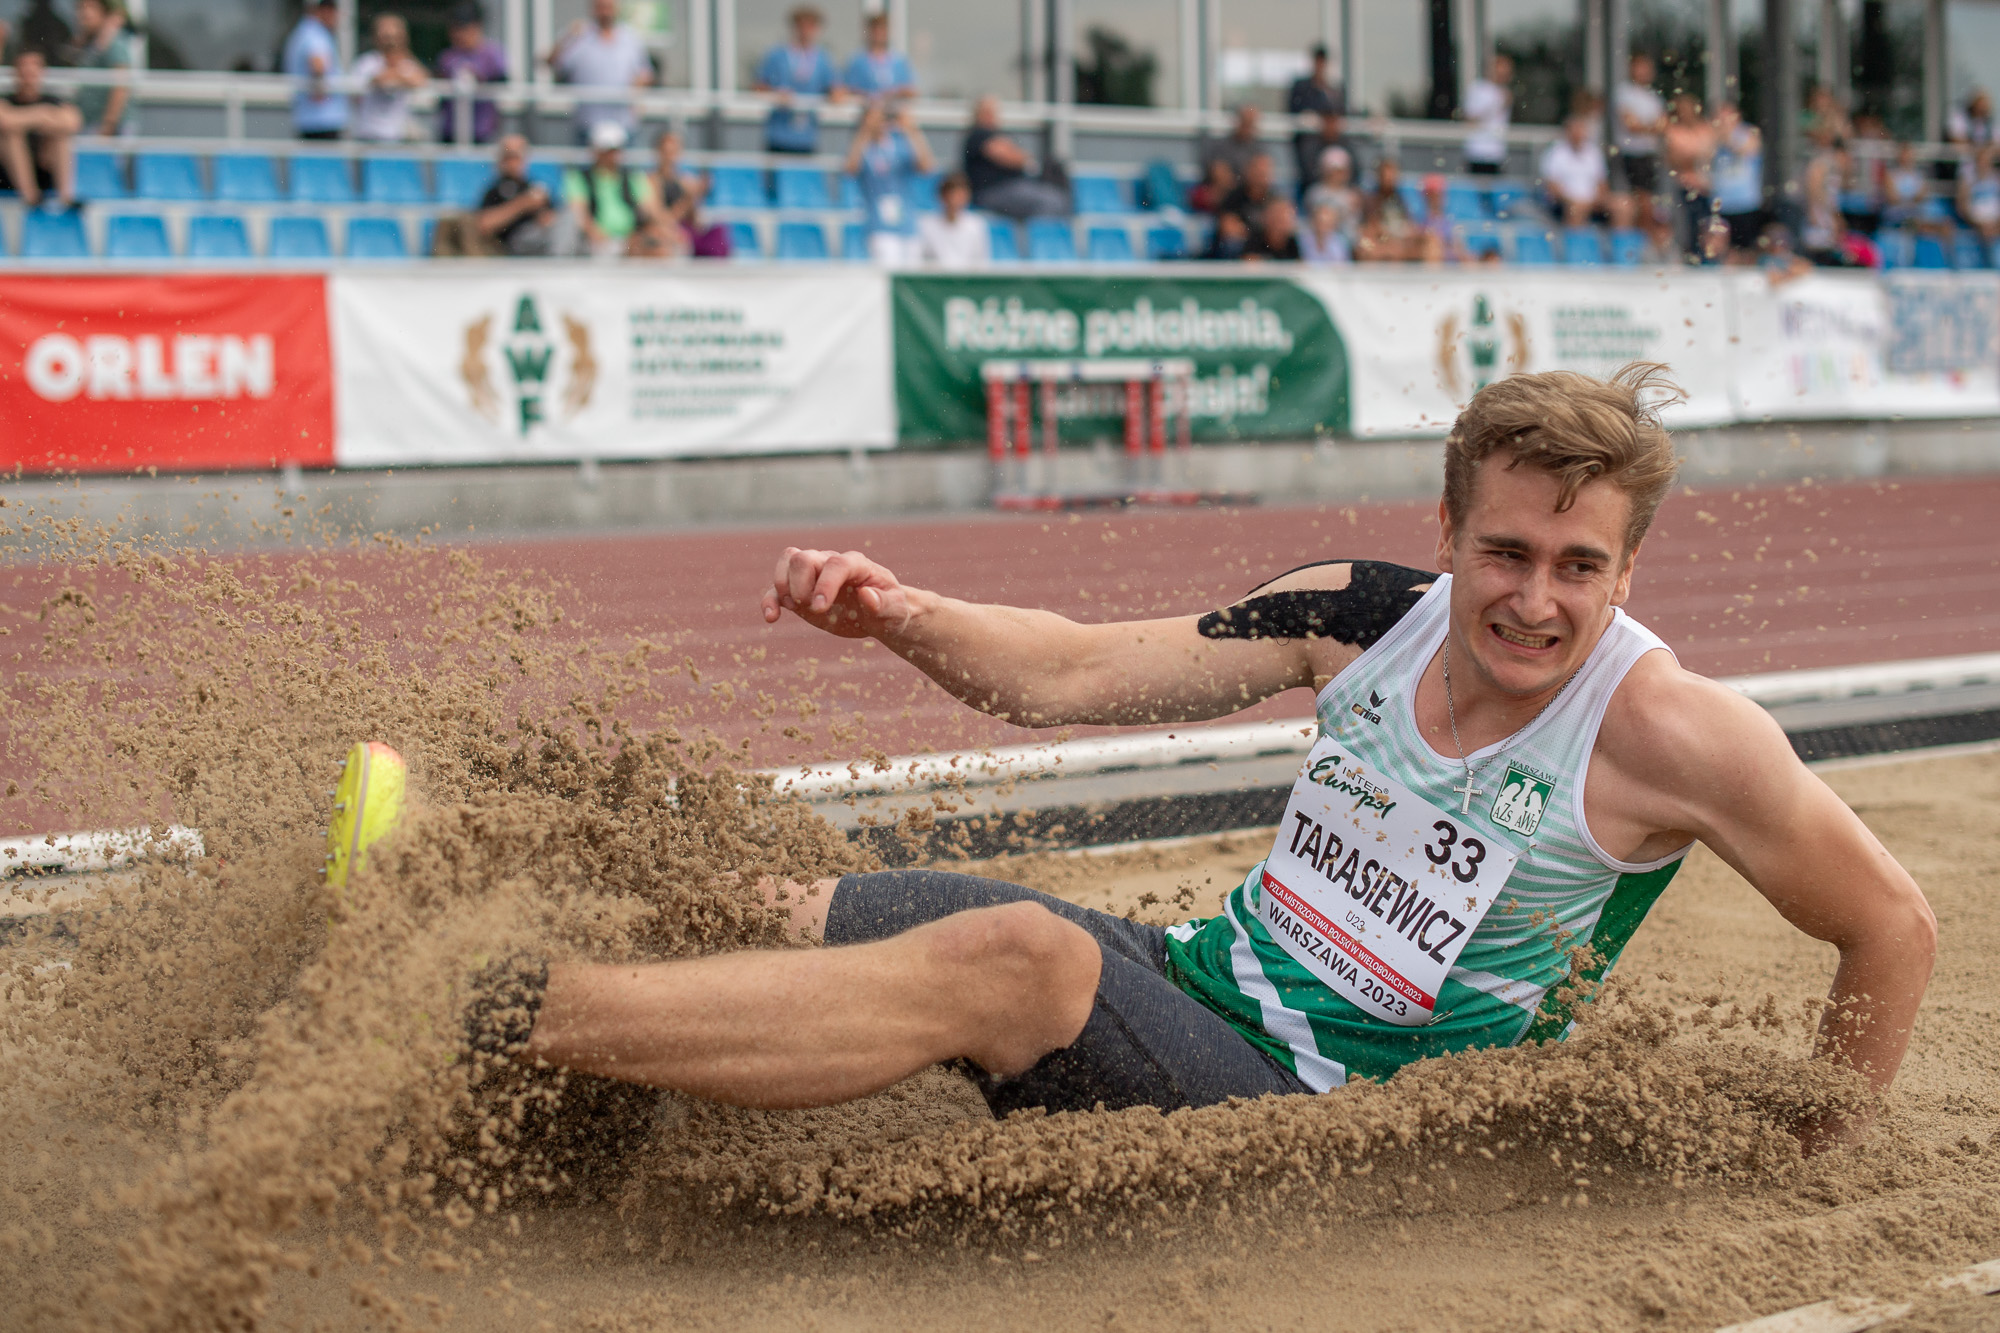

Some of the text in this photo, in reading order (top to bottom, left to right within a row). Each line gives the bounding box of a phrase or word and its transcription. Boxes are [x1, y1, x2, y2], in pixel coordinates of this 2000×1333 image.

[944, 297, 1292, 356] Różne pokolenia,
[24, 332, 275, 402] ORLEN
[1308, 755, 1396, 820] Europol
[1342, 766, 1383, 794] INTER
[1509, 759, 1557, 784] WARSZAWA
[1493, 802, 1537, 832] AZS AWF
[1424, 820, 1487, 883] 33
[1288, 809, 1467, 966] TARASIEWICZ
[1282, 892, 1329, 934] MISTRZOSTWA
[1327, 926, 1352, 950] POLSKI
[1351, 943, 1360, 955] W
[1358, 949, 1405, 990] WIELOBOJACH
[1403, 985, 1423, 1002] 2023
[1345, 911, 1366, 931] U23
[1269, 901, 1408, 1017] WARSZAWA 2023
